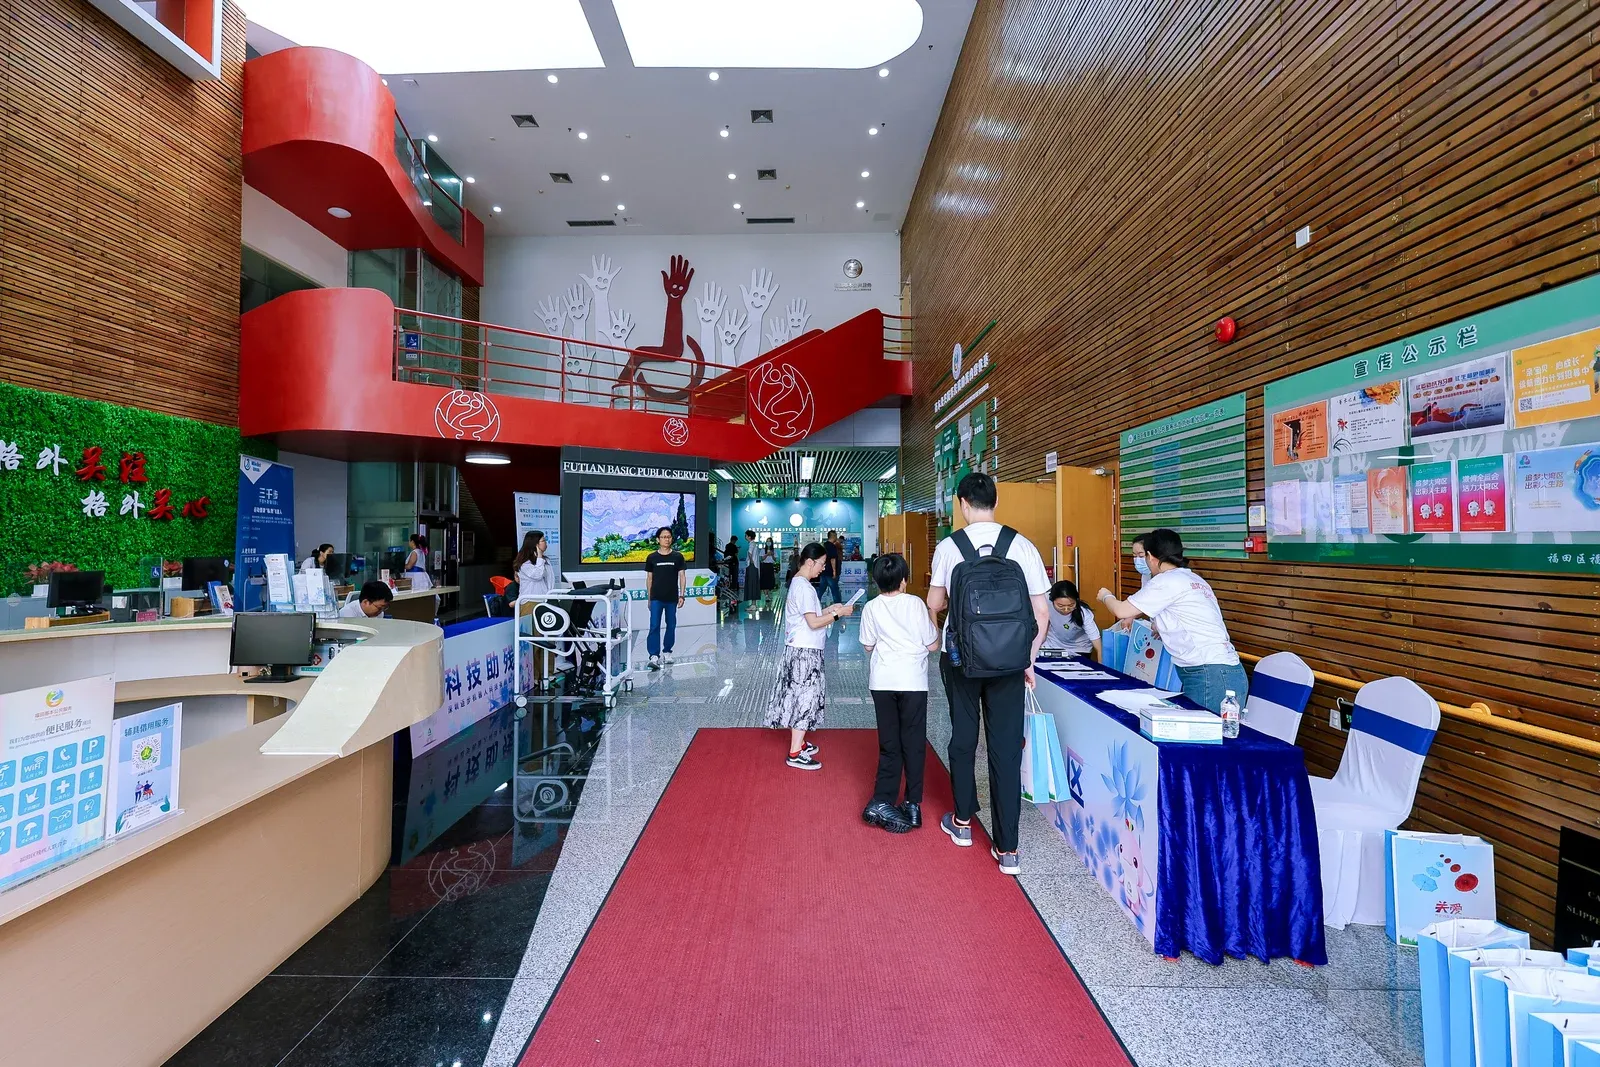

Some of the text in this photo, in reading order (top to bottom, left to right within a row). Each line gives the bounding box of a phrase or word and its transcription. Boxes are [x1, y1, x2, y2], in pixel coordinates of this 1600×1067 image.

[1354, 325, 1477, 378] 宣传公示栏
[0, 440, 148, 483] 格外关注
[563, 461, 709, 481] FUTIAN BASIC PUBLIC SERVICE
[1525, 472, 1564, 482] 追梦大湾区
[1525, 480, 1564, 490] 出彩人生路
[1415, 486, 1448, 496] 出彩人生路
[81, 488, 211, 521] 格外关心
[1547, 553, 1600, 565] 福田区福
[444, 644, 515, 700] 科技助残
[124, 717, 169, 737] 辅具借用服务
[24, 764, 41, 773] WiFi
[1067, 746, 1085, 808] 区
[1435, 900, 1463, 915] 关爱
